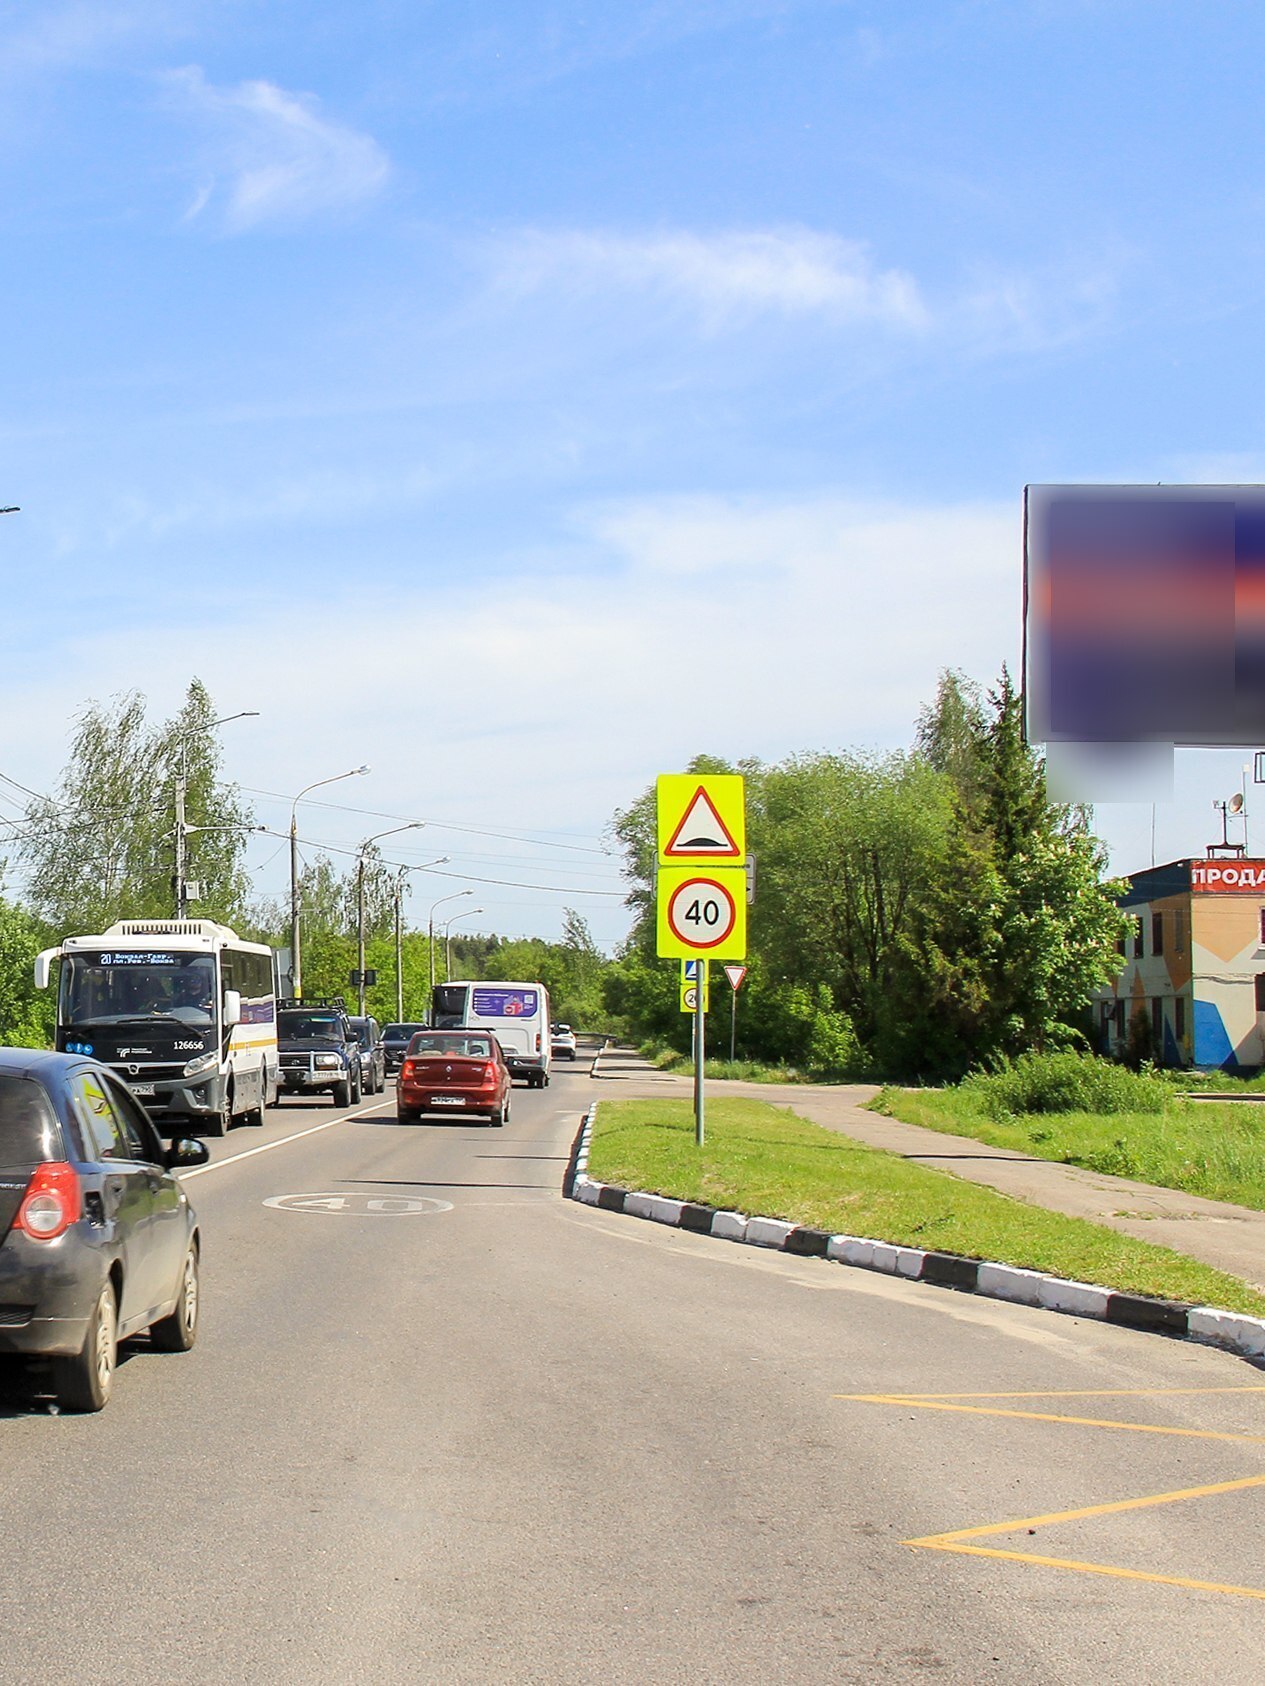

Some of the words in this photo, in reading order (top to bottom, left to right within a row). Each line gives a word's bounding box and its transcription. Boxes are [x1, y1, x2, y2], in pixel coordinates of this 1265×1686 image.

[685, 900, 719, 926] 40
[100, 953, 112, 965] 20
[173, 1041, 204, 1050] 126656
[292, 1198, 423, 1211] 40
